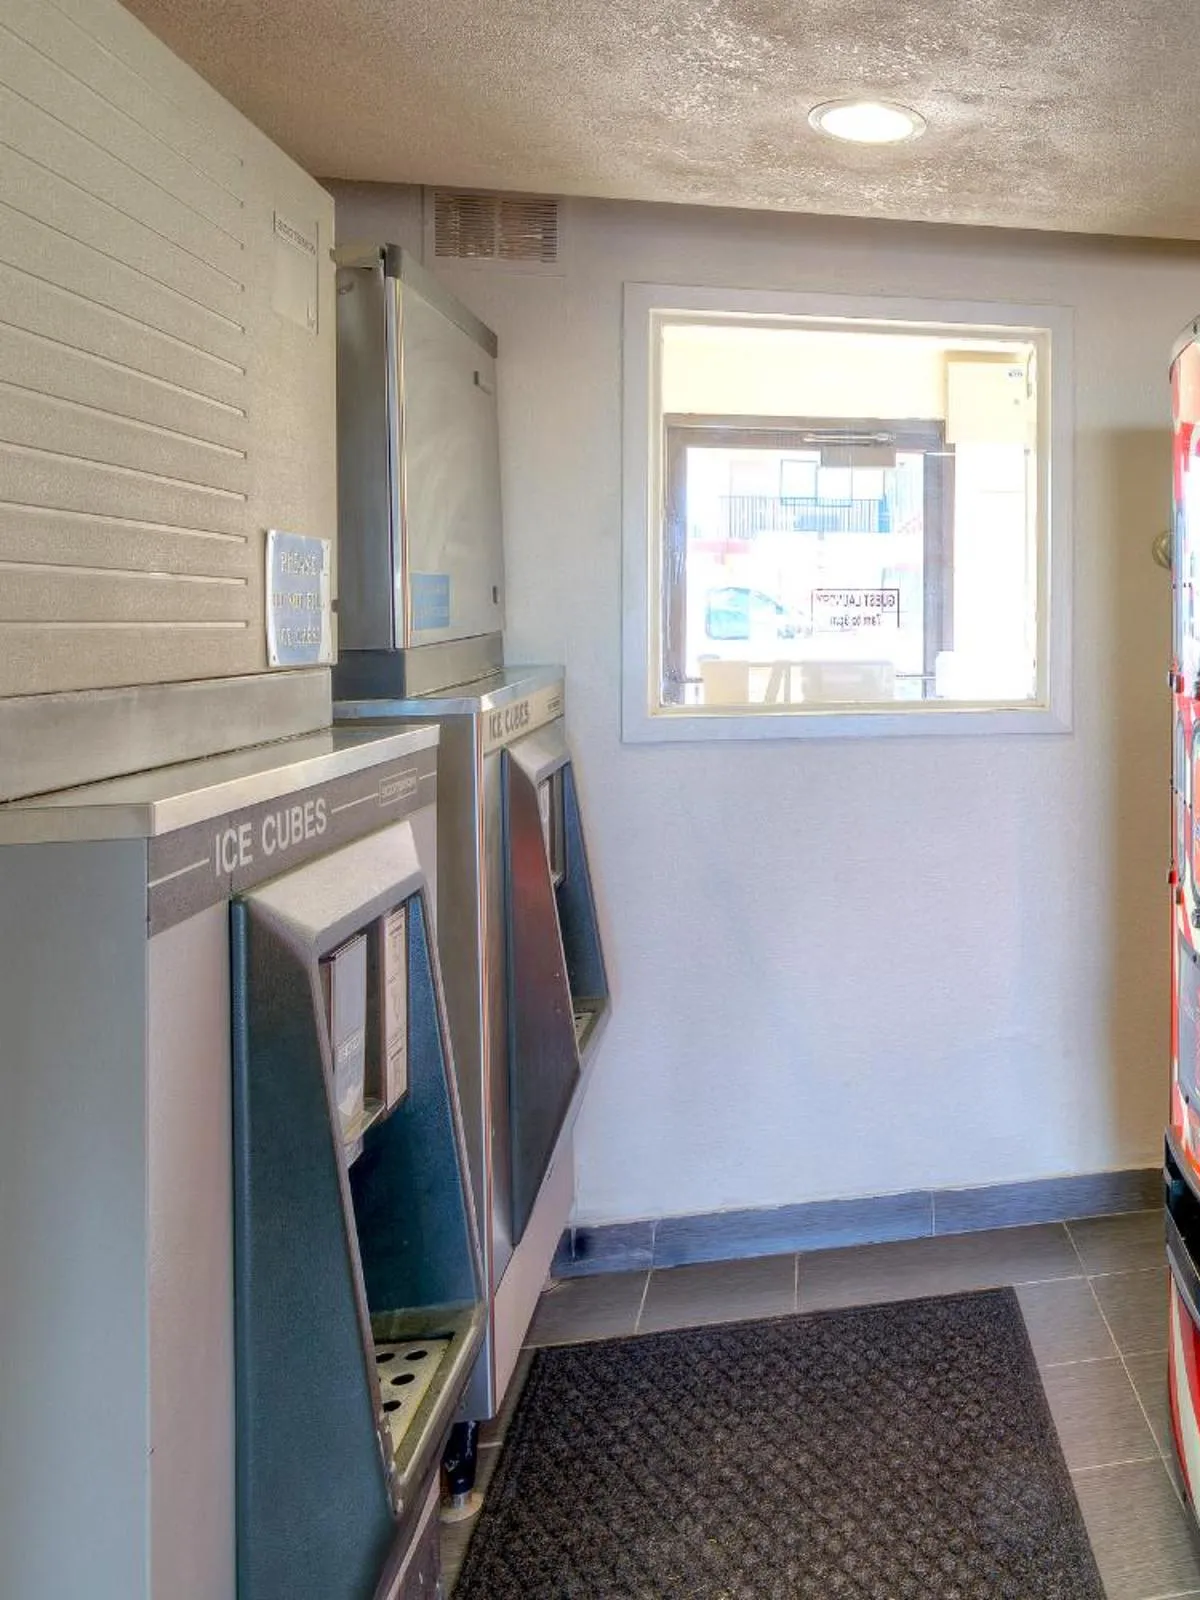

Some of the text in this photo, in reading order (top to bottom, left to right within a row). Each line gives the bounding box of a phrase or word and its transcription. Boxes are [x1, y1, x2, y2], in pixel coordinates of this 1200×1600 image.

[489, 711, 502, 742] ICE
[505, 699, 529, 734] CUBES
[215, 797, 327, 877] ICE CUBES
